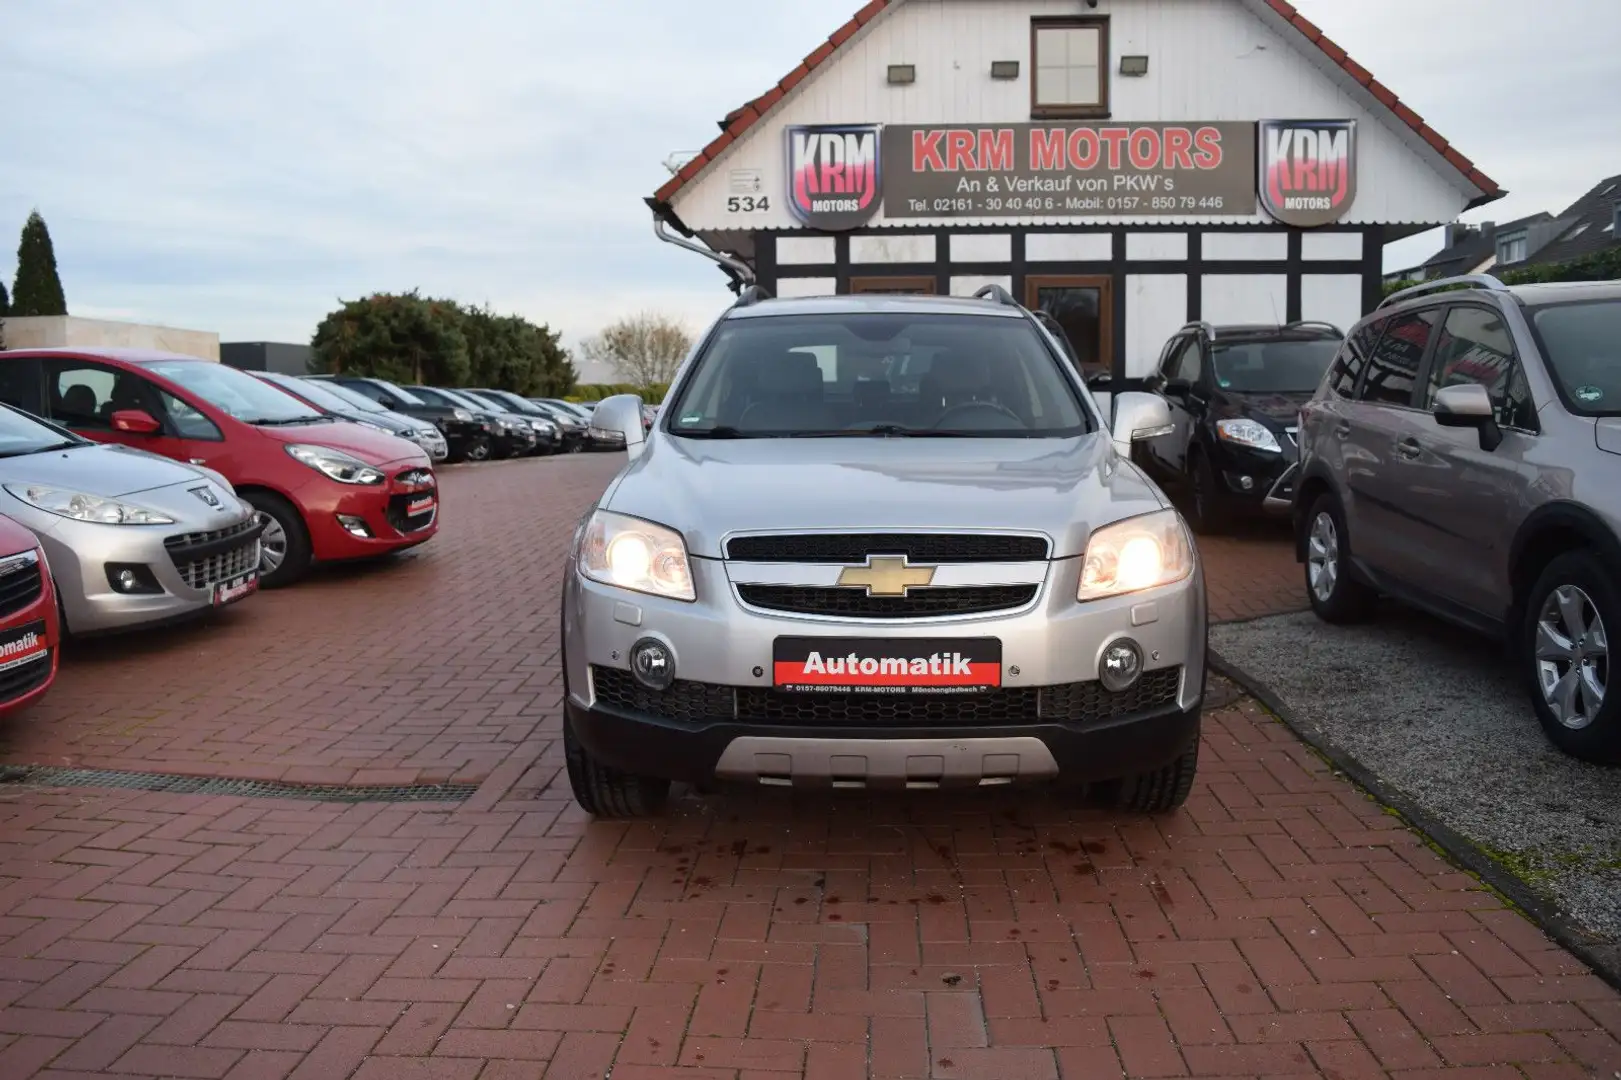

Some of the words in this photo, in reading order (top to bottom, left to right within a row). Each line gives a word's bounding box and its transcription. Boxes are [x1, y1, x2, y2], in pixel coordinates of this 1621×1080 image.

[912, 129, 1015, 172] KRM
[1029, 127, 1223, 171] MOTORS
[795, 133, 875, 211] KRM
[1268, 129, 1348, 208] KRM
[956, 177, 982, 192] An
[986, 177, 1000, 192] &
[1004, 176, 1073, 192] Verkauf
[1076, 179, 1108, 191] von
[727, 195, 770, 213] 534
[812, 200, 858, 213] MOTORS
[908, 199, 931, 212] Tel.
[933, 199, 973, 212] 02161
[985, 199, 1002, 211] 30
[1005, 199, 1021, 211] 40
[1024, 199, 1041, 211] 40
[1045, 199, 1054, 211] 6
[1066, 197, 1104, 211] Mobil:
[1107, 197, 1139, 210] 0157
[1152, 197, 1177, 210] 850
[1180, 197, 1196, 210] 79
[1198, 197, 1224, 210] 446
[1285, 197, 1331, 210] MOTORS
[803, 651, 972, 675] Automatik
